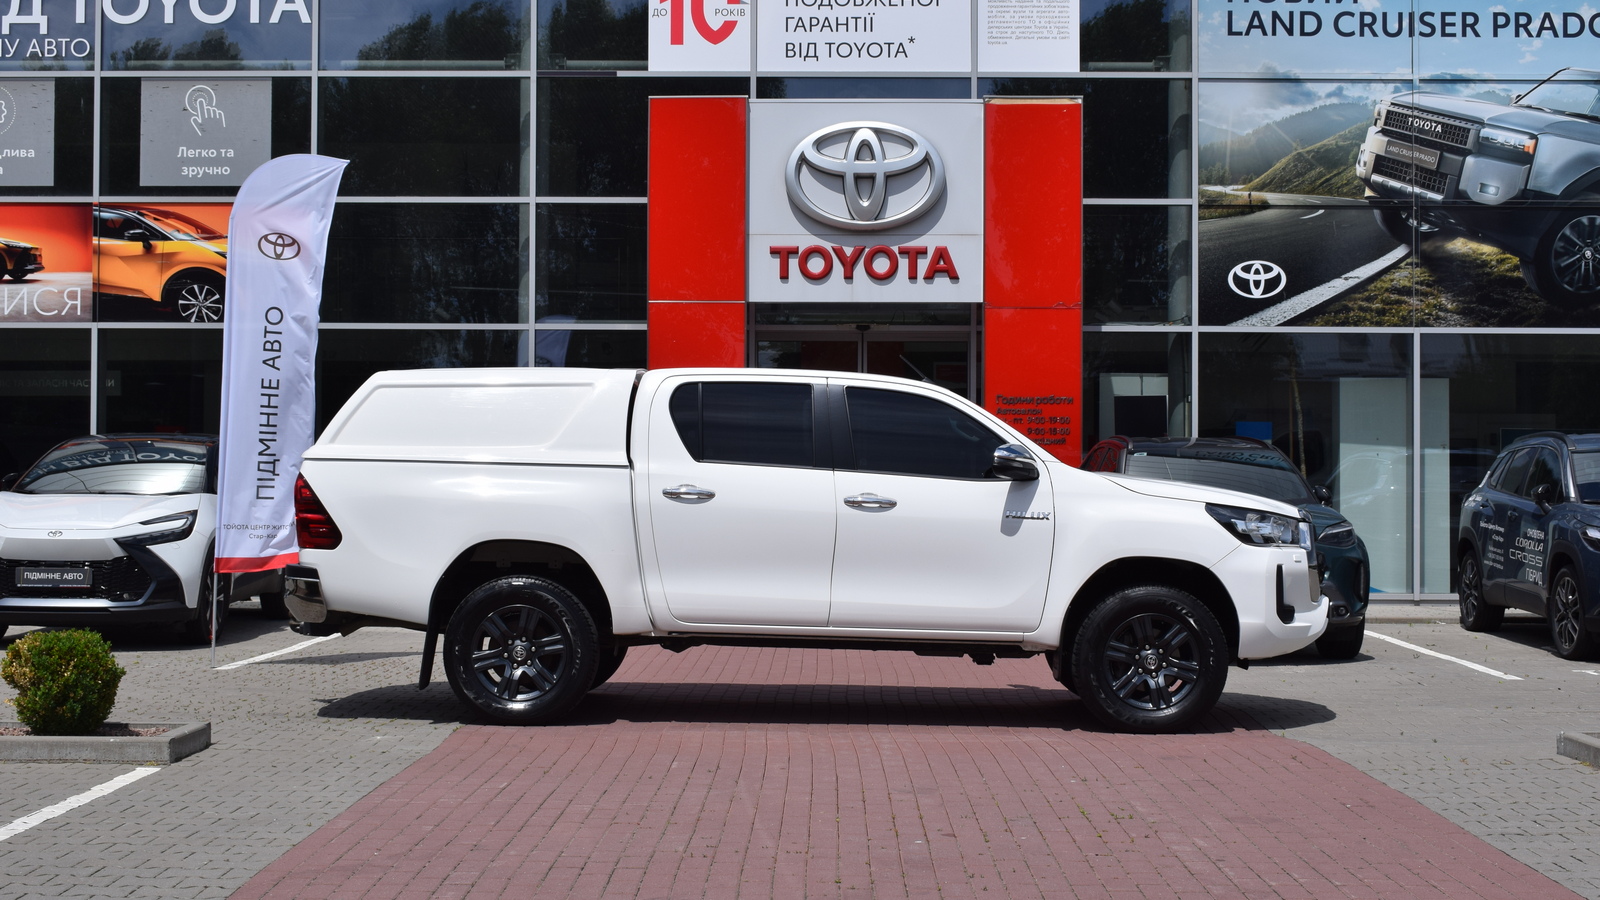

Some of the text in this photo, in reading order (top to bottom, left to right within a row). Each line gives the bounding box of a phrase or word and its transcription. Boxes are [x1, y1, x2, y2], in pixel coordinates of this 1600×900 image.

[651, 8, 668, 18] ДО
[714, 8, 746, 17] РОКІВ
[785, 12, 876, 33] ГАРАНТІЇ
[1227, 10, 1322, 37] LAND
[1333, 10, 1481, 38] CRUISER
[0, 38, 90, 58] У АВТО
[785, 42, 819, 62] ВІД
[1408, 117, 1442, 133] TOYOTA
[0, 149, 35, 159] лива
[177, 146, 234, 158] Легко та
[1387, 145, 1399, 153] LAND
[1419, 153, 1436, 163] PRADO
[181, 166, 231, 178] зручно
[769, 245, 960, 281] TOYOTA
[4, 287, 81, 315] ИСЯ
[256, 306, 284, 500] ПІДМІННЕ АВТО
[996, 394, 1074, 406] Години роботи
[996, 407, 1042, 415] Автосалон
[1006, 511, 1051, 520] HILUX
[1515, 537, 1544, 552] COROLLA
[1509, 548, 1543, 567] CROSS
[24, 572, 84, 581] ПІДМІННЕ АВТО
